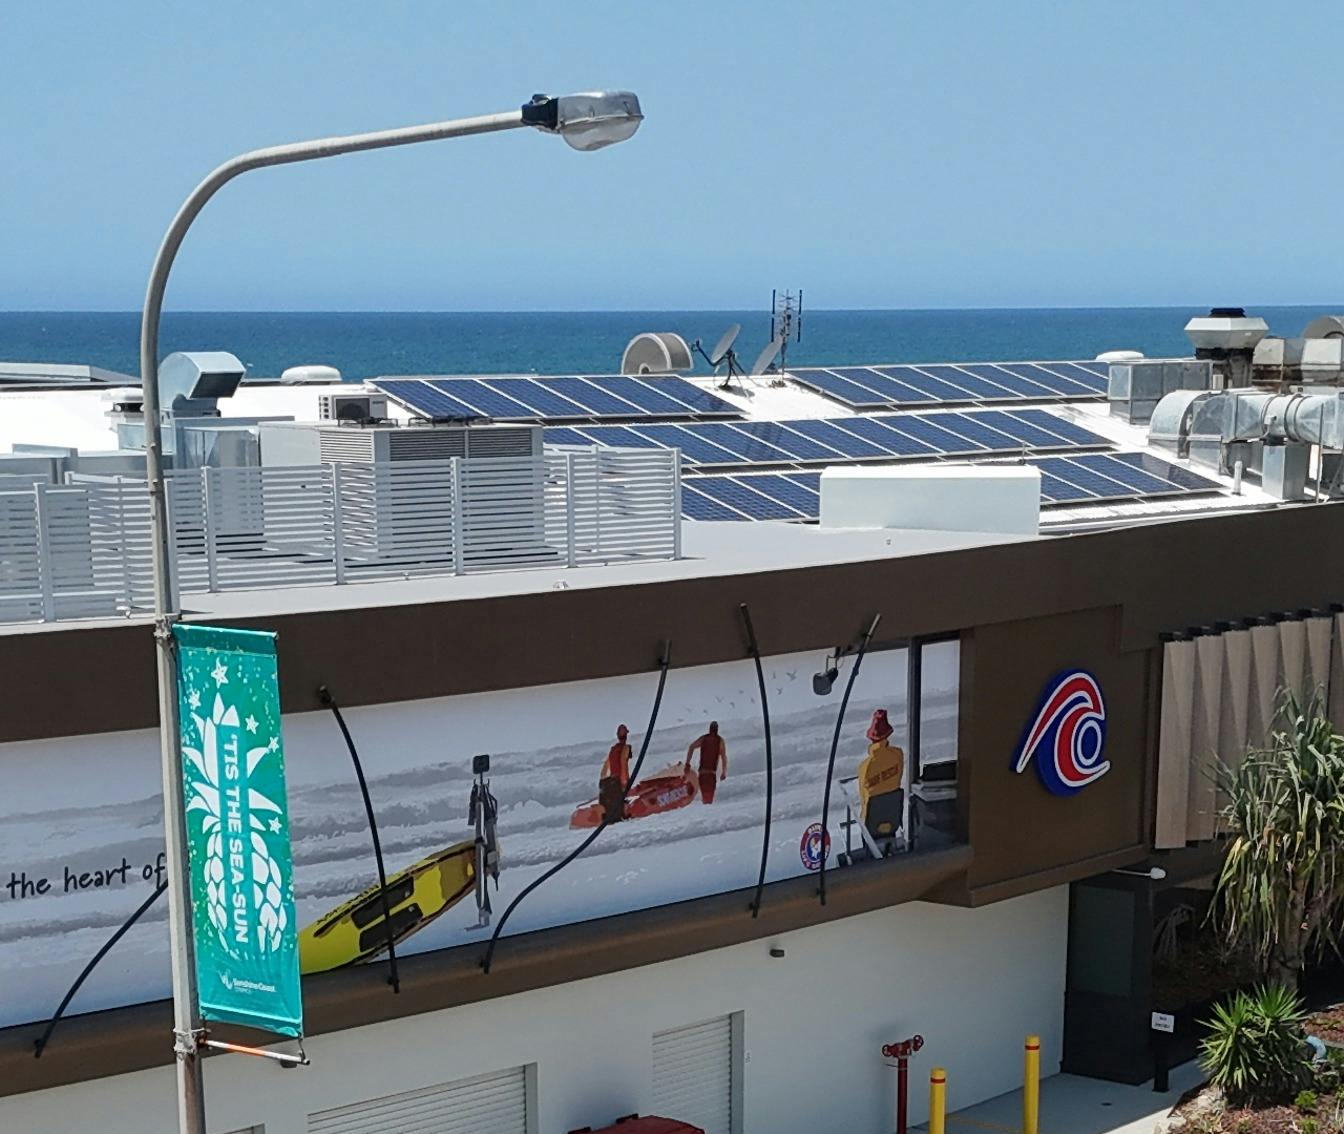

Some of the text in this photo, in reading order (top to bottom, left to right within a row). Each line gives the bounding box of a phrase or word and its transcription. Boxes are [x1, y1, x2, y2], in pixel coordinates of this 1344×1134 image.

[226, 786, 242, 834] THE
[6, 852, 166, 899] the heart of
[229, 838, 248, 943] SEA-SUN
